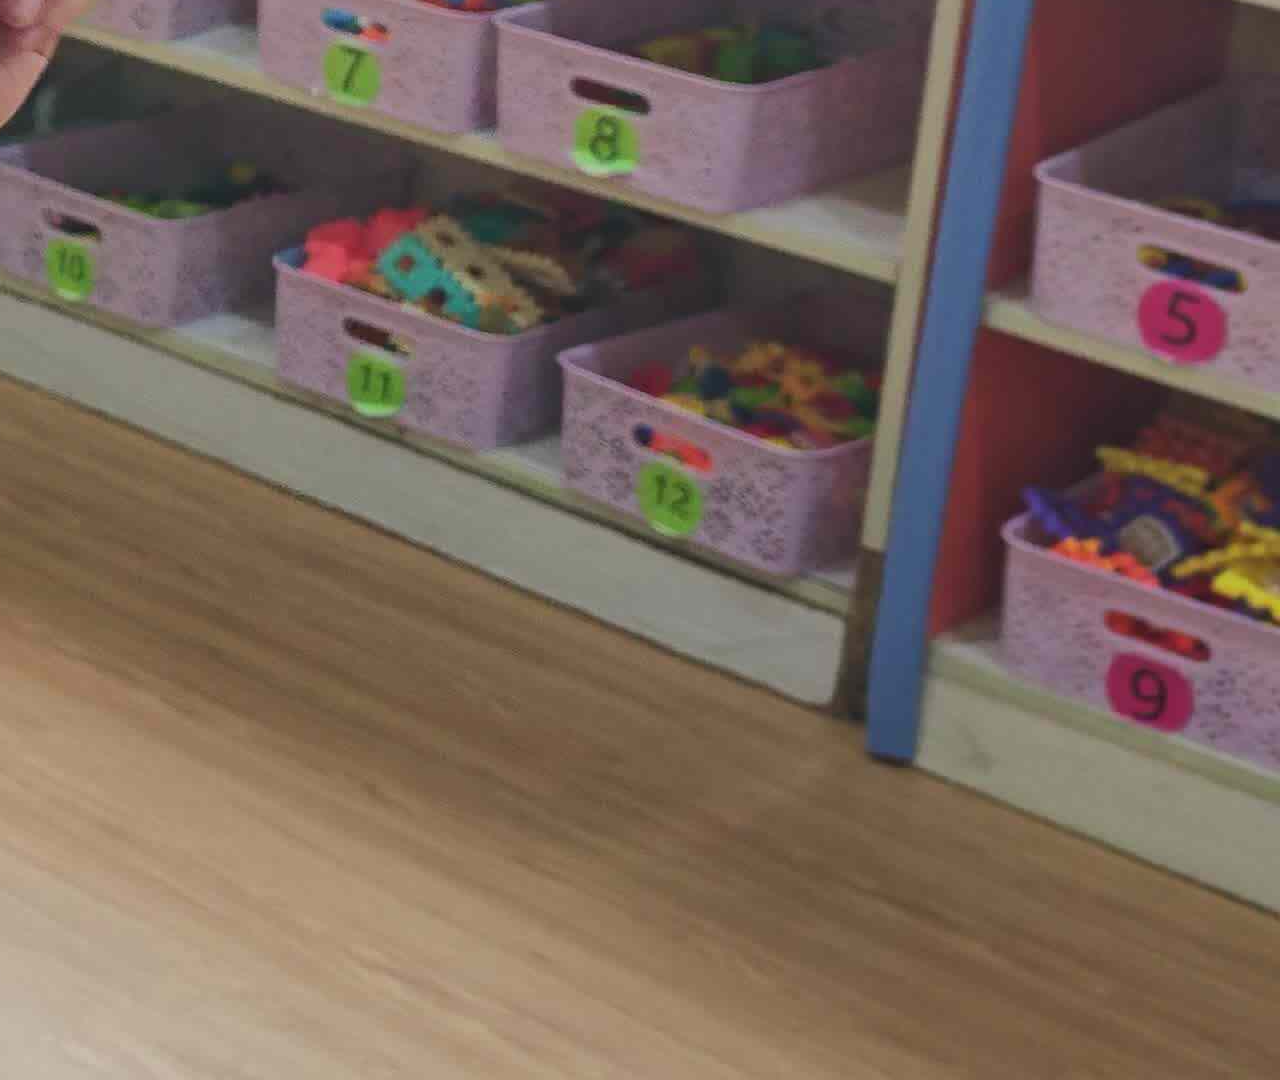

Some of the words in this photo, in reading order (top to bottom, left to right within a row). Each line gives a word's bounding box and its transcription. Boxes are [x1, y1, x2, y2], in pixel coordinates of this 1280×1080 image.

[337, 42, 368, 93] 7
[589, 116, 619, 162] 8
[1159, 290, 1200, 347] 5
[359, 362, 391, 401] 11
[655, 474, 691, 519] 12
[1129, 667, 1168, 722] 9
